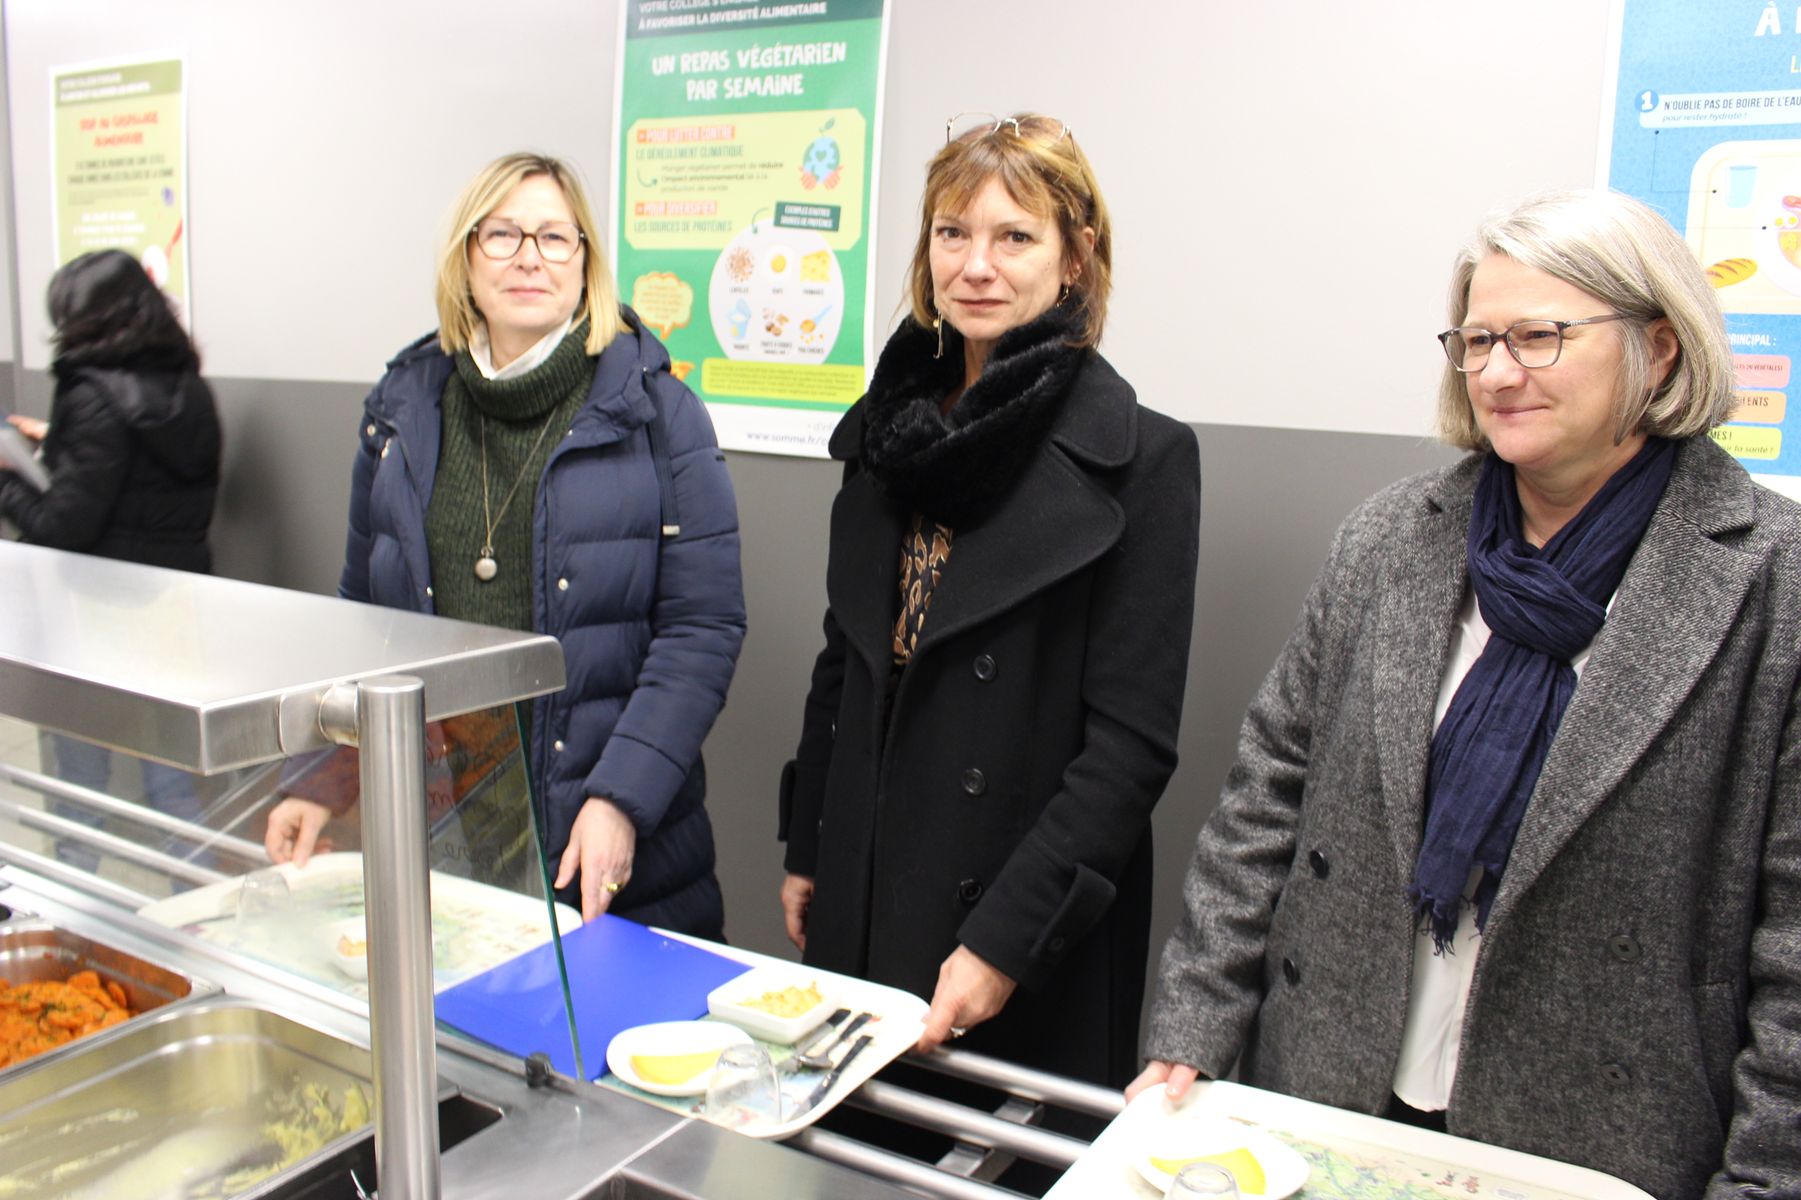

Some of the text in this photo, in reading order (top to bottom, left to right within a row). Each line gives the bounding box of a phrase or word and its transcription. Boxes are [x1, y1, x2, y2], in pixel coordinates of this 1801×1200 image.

[646, 14, 695, 27] FAVORISER
[696, 12, 709, 24] LA
[709, 6, 759, 23] DIVERSITÉ
[760, 2, 827, 18] ALIMENTAIRE
[1752, 0, 1782, 37] À
[652, 55, 675, 76] UN
[680, 50, 730, 74] REPAS
[686, 79, 717, 101] PAR
[1640, 91, 1653, 110] 1
[1664, 99, 1702, 111] N'OUBLIE
[1704, 99, 1721, 110] PAS
[1722, 98, 1733, 109] DE
[1736, 97, 1761, 109] BOIRE
[1764, 97, 1775, 108] DE
[1662, 113, 1682, 123] pour
